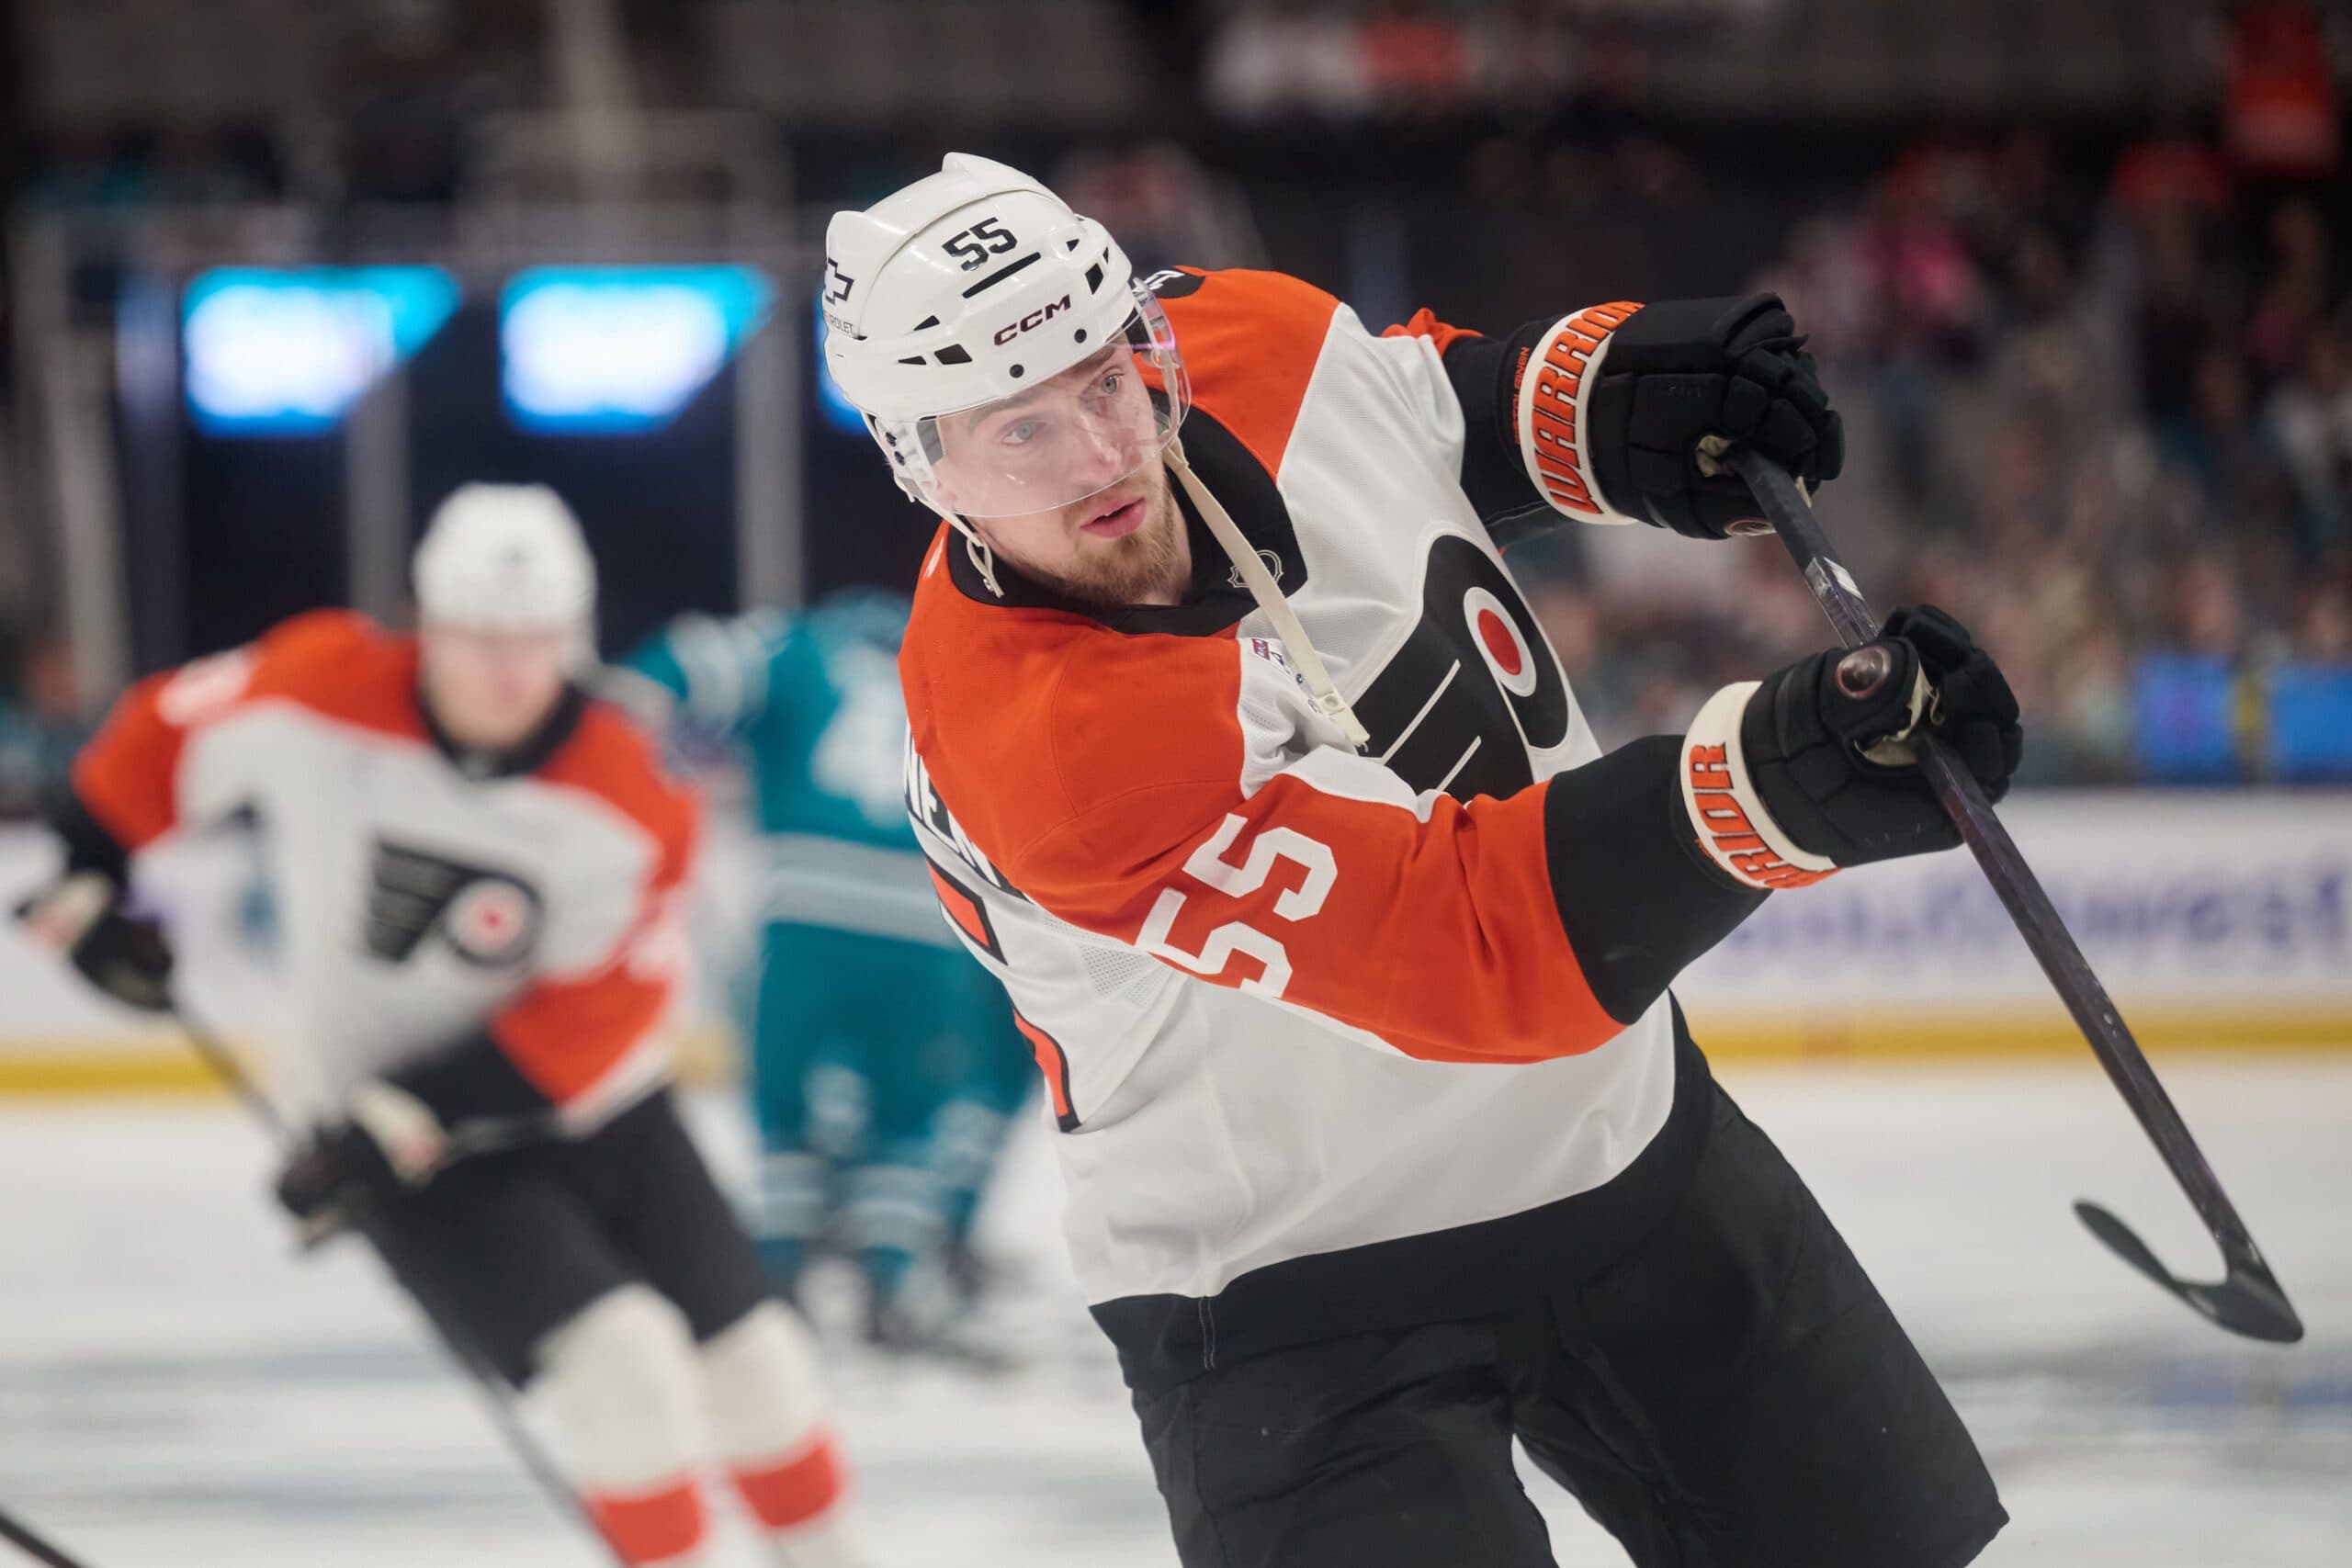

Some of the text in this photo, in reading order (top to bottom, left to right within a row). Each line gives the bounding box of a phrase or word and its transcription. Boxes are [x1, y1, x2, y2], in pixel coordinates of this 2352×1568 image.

[942, 217, 1018, 272] 55
[993, 293, 1072, 346] CCM
[1134, 812, 1339, 999] 55
